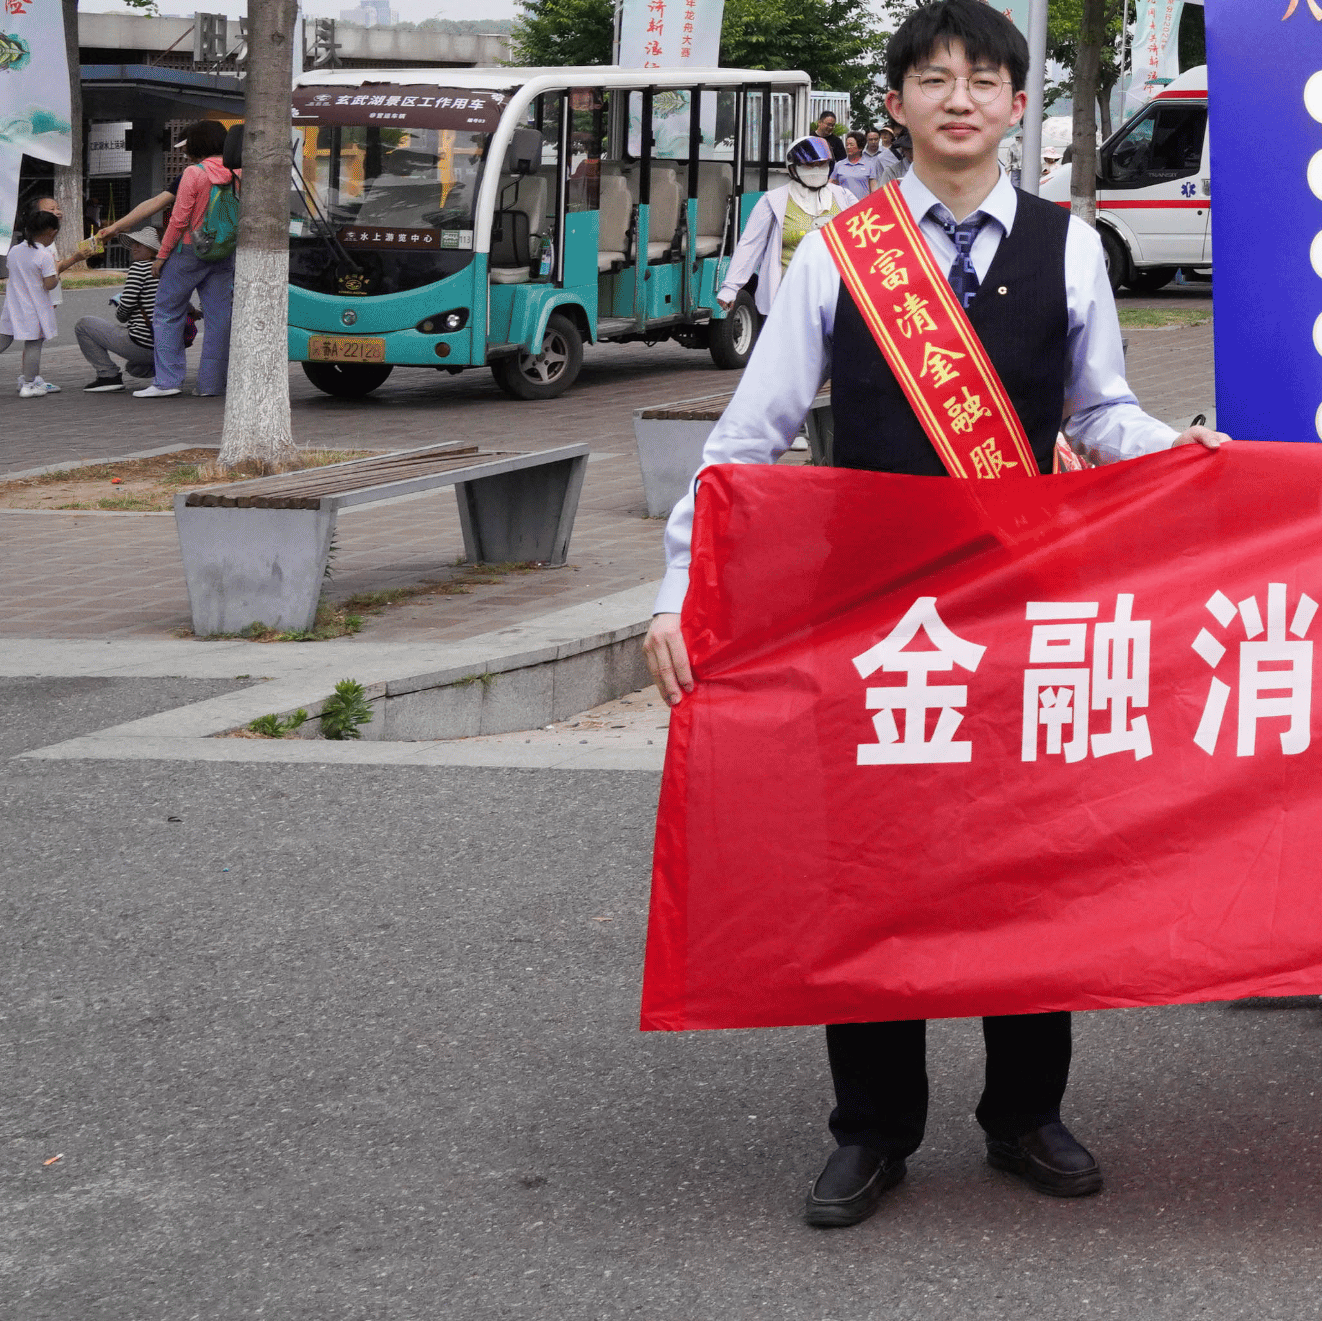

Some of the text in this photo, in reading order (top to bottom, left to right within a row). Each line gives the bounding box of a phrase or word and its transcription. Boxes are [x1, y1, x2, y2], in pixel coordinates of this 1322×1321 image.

[335, 95, 486, 110] 玄武湖景区工作用车
[360, 233, 433, 243] 水上游览中心
[846, 207, 1019, 478] 张富清金融服
